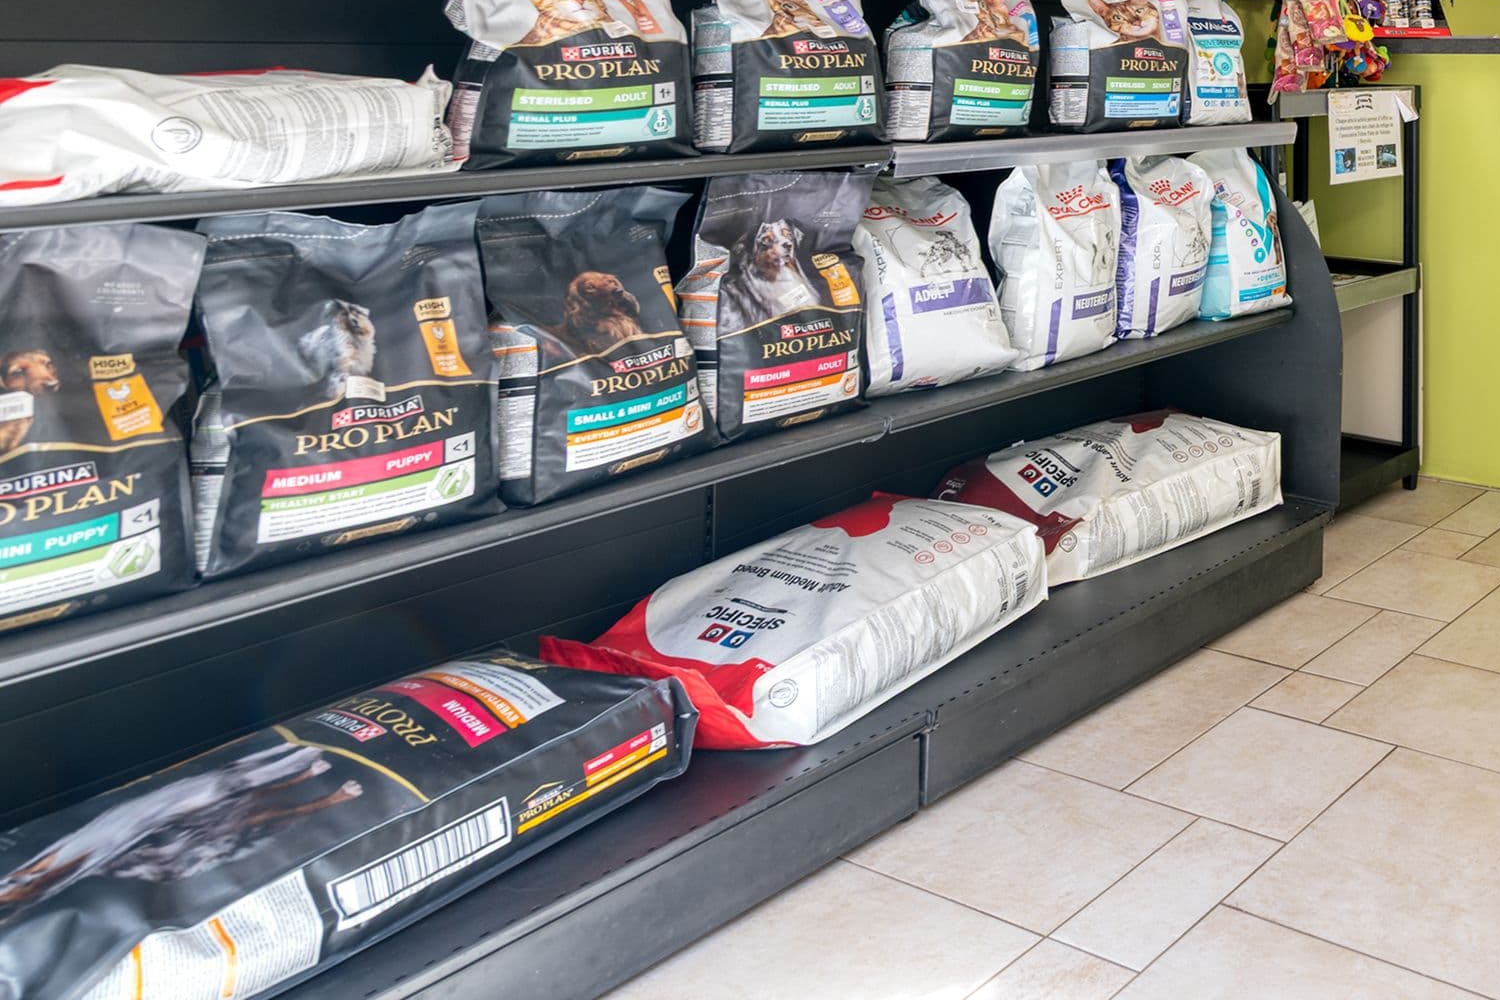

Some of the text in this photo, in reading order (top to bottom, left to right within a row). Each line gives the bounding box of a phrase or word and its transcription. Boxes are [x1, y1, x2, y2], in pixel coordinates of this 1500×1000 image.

[581, 44, 636, 58] PURINA
[779, 53, 866, 70] PRO PLAN
[1000, 50, 1029, 61] PURINA
[536, 59, 660, 81] PRO PLAN
[971, 59, 1038, 78] PRO PLAN
[1120, 59, 1178, 72] PRO PLAN
[519, 88, 671, 106] STERILISED ADULT 1+
[765, 81, 857, 92] STERILISED ADULT
[959, 84, 1001, 94] STERILISED
[517, 114, 577, 123] RENAL PLUS
[1055, 238, 1063, 290] EXPERT
[418, 301, 445, 311] HIGH
[794, 321, 830, 333] PURINA
[762, 330, 853, 360] PRO PLAN
[93, 359, 128, 370] HIGH
[626, 347, 671, 368] PURINA
[590, 358, 691, 397] PRO PLAN
[750, 359, 843, 384] MEDIUM ADULT
[750, 381, 822, 400] EVERYDAY NUTRITION
[354, 400, 420, 421] PURINA
[574, 392, 683, 426] SMALL & MINI ADULT
[293, 409, 455, 456] PRO PLAN
[574, 418, 662, 444] EVERYDAY NUTRITION
[272, 440, 470, 489] MEDIUM PUPPY <1
[1024, 451, 1078, 488] SPECIFIC
[0, 465, 93, 496] PURINA
[24, 476, 136, 522] PLAN
[271, 487, 366, 510] HEALTHY START
[45, 508, 153, 551] PUPPY <1
[732, 564, 853, 593] Adult Medium Breed
[705, 605, 786, 632] SPECIFIC
[317, 712, 358, 732] PURINA
[376, 702, 438, 747] PRO
[442, 699, 491, 737] MEDIUM
[519, 788, 573, 822] PRO PLAN
